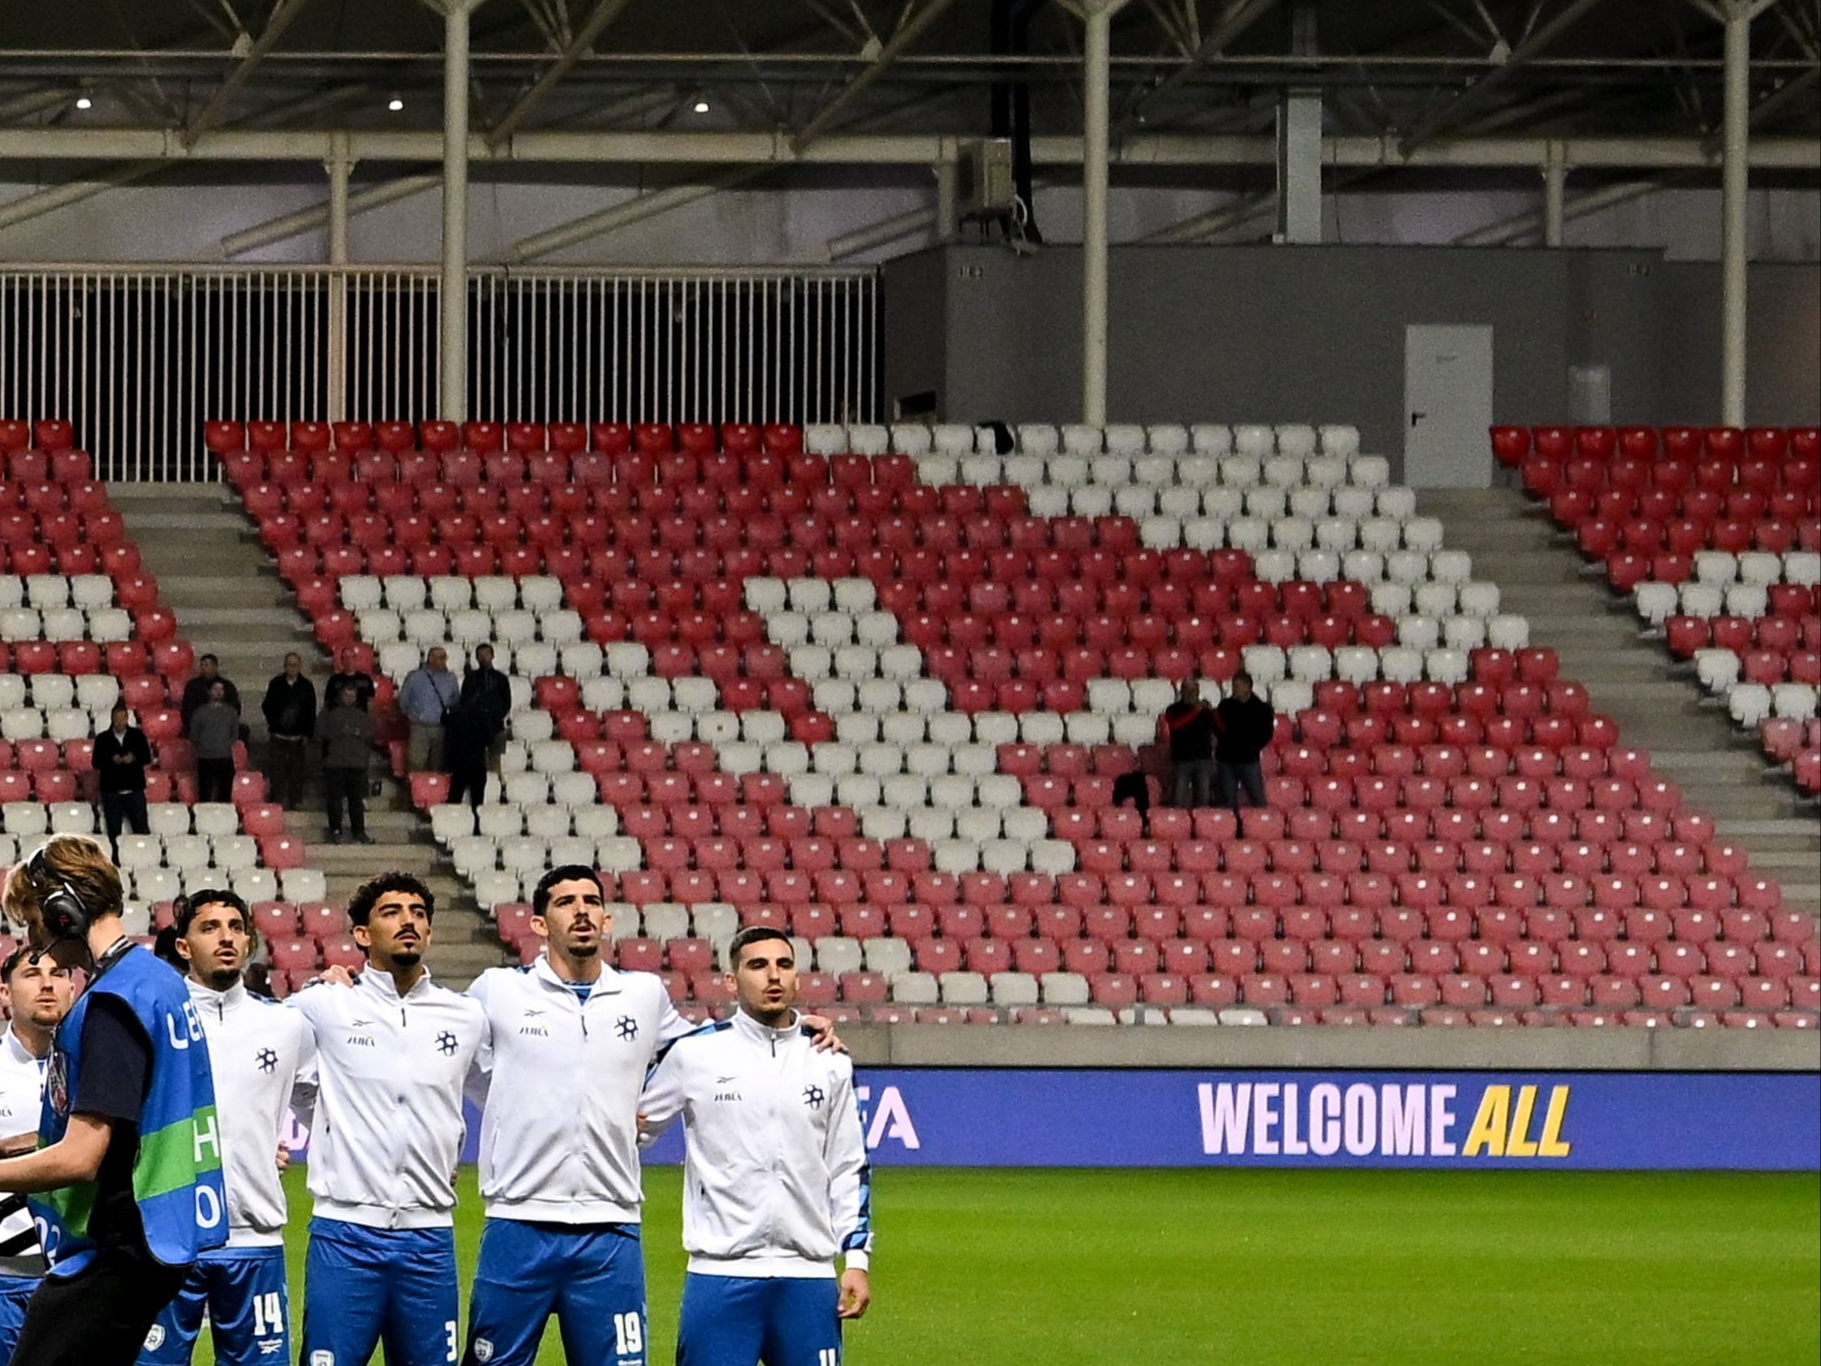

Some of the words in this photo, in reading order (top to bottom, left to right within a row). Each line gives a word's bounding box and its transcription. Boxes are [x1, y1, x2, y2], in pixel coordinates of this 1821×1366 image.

[1197, 1082, 1457, 1156] WELCOME
[1462, 1084, 1572, 1157] ALL
[253, 1292, 284, 1336] 14
[614, 1311, 643, 1355] 19
[445, 1320, 457, 1362] 3
